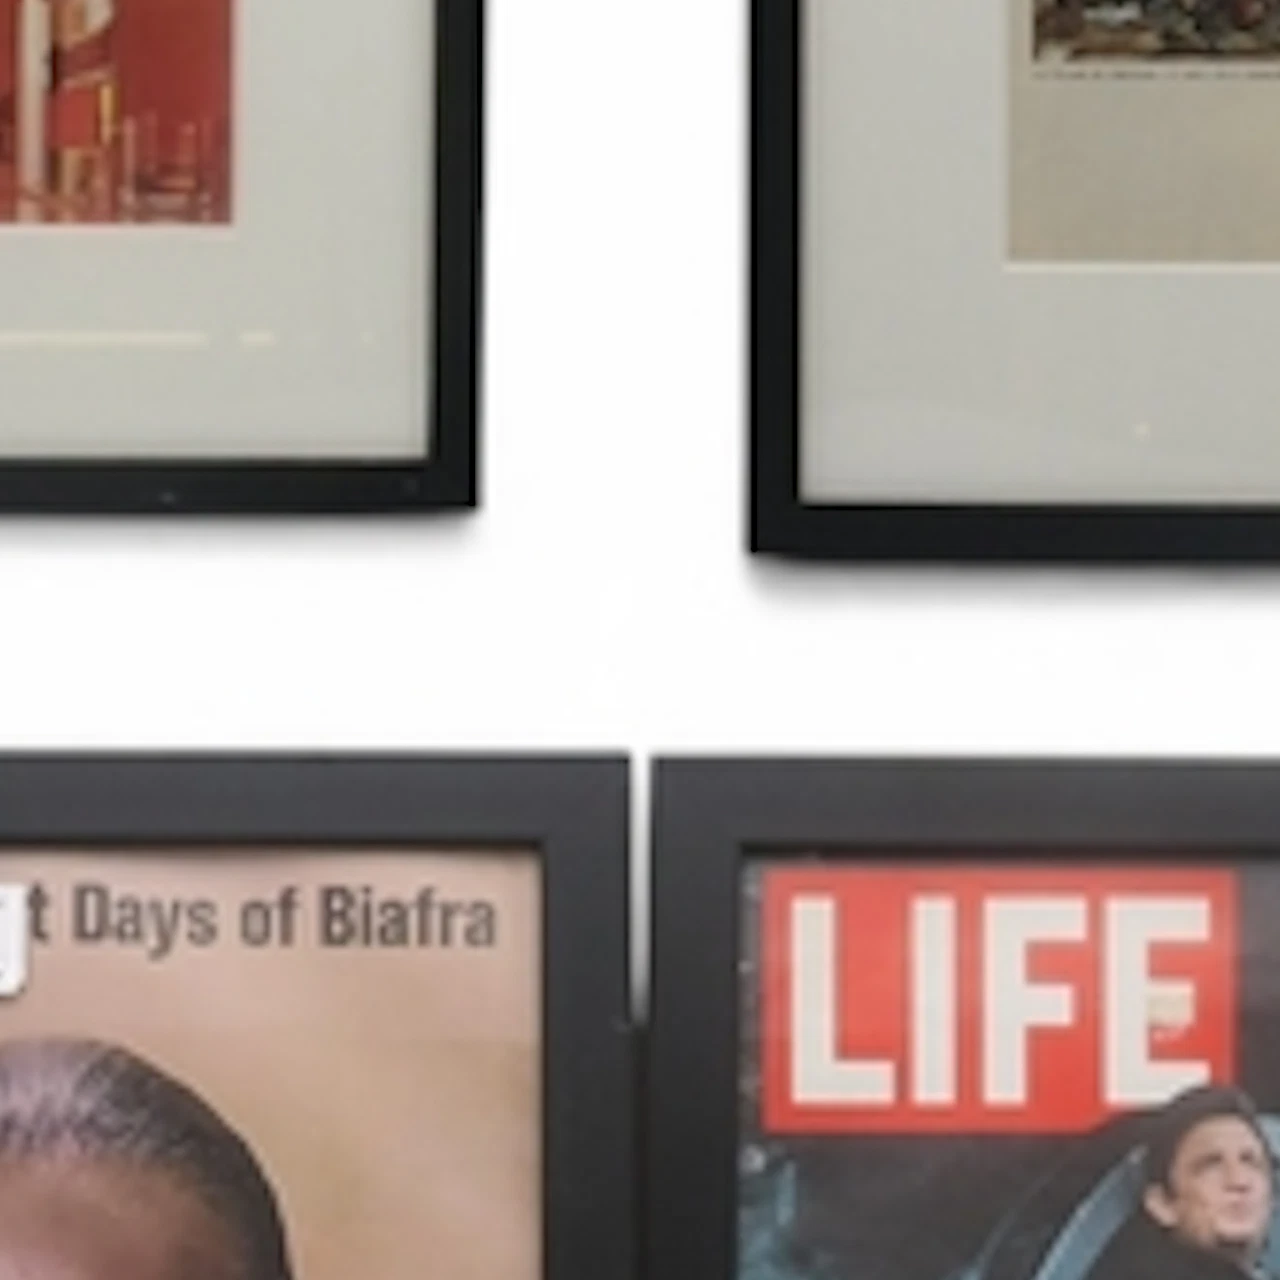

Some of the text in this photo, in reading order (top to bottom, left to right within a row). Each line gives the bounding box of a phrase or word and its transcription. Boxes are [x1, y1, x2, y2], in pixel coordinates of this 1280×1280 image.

[73, 882, 220, 963] Days
[238, 885, 301, 947] of
[321, 885, 498, 948] Biafra
[788, 894, 1211, 1108] LIFE
